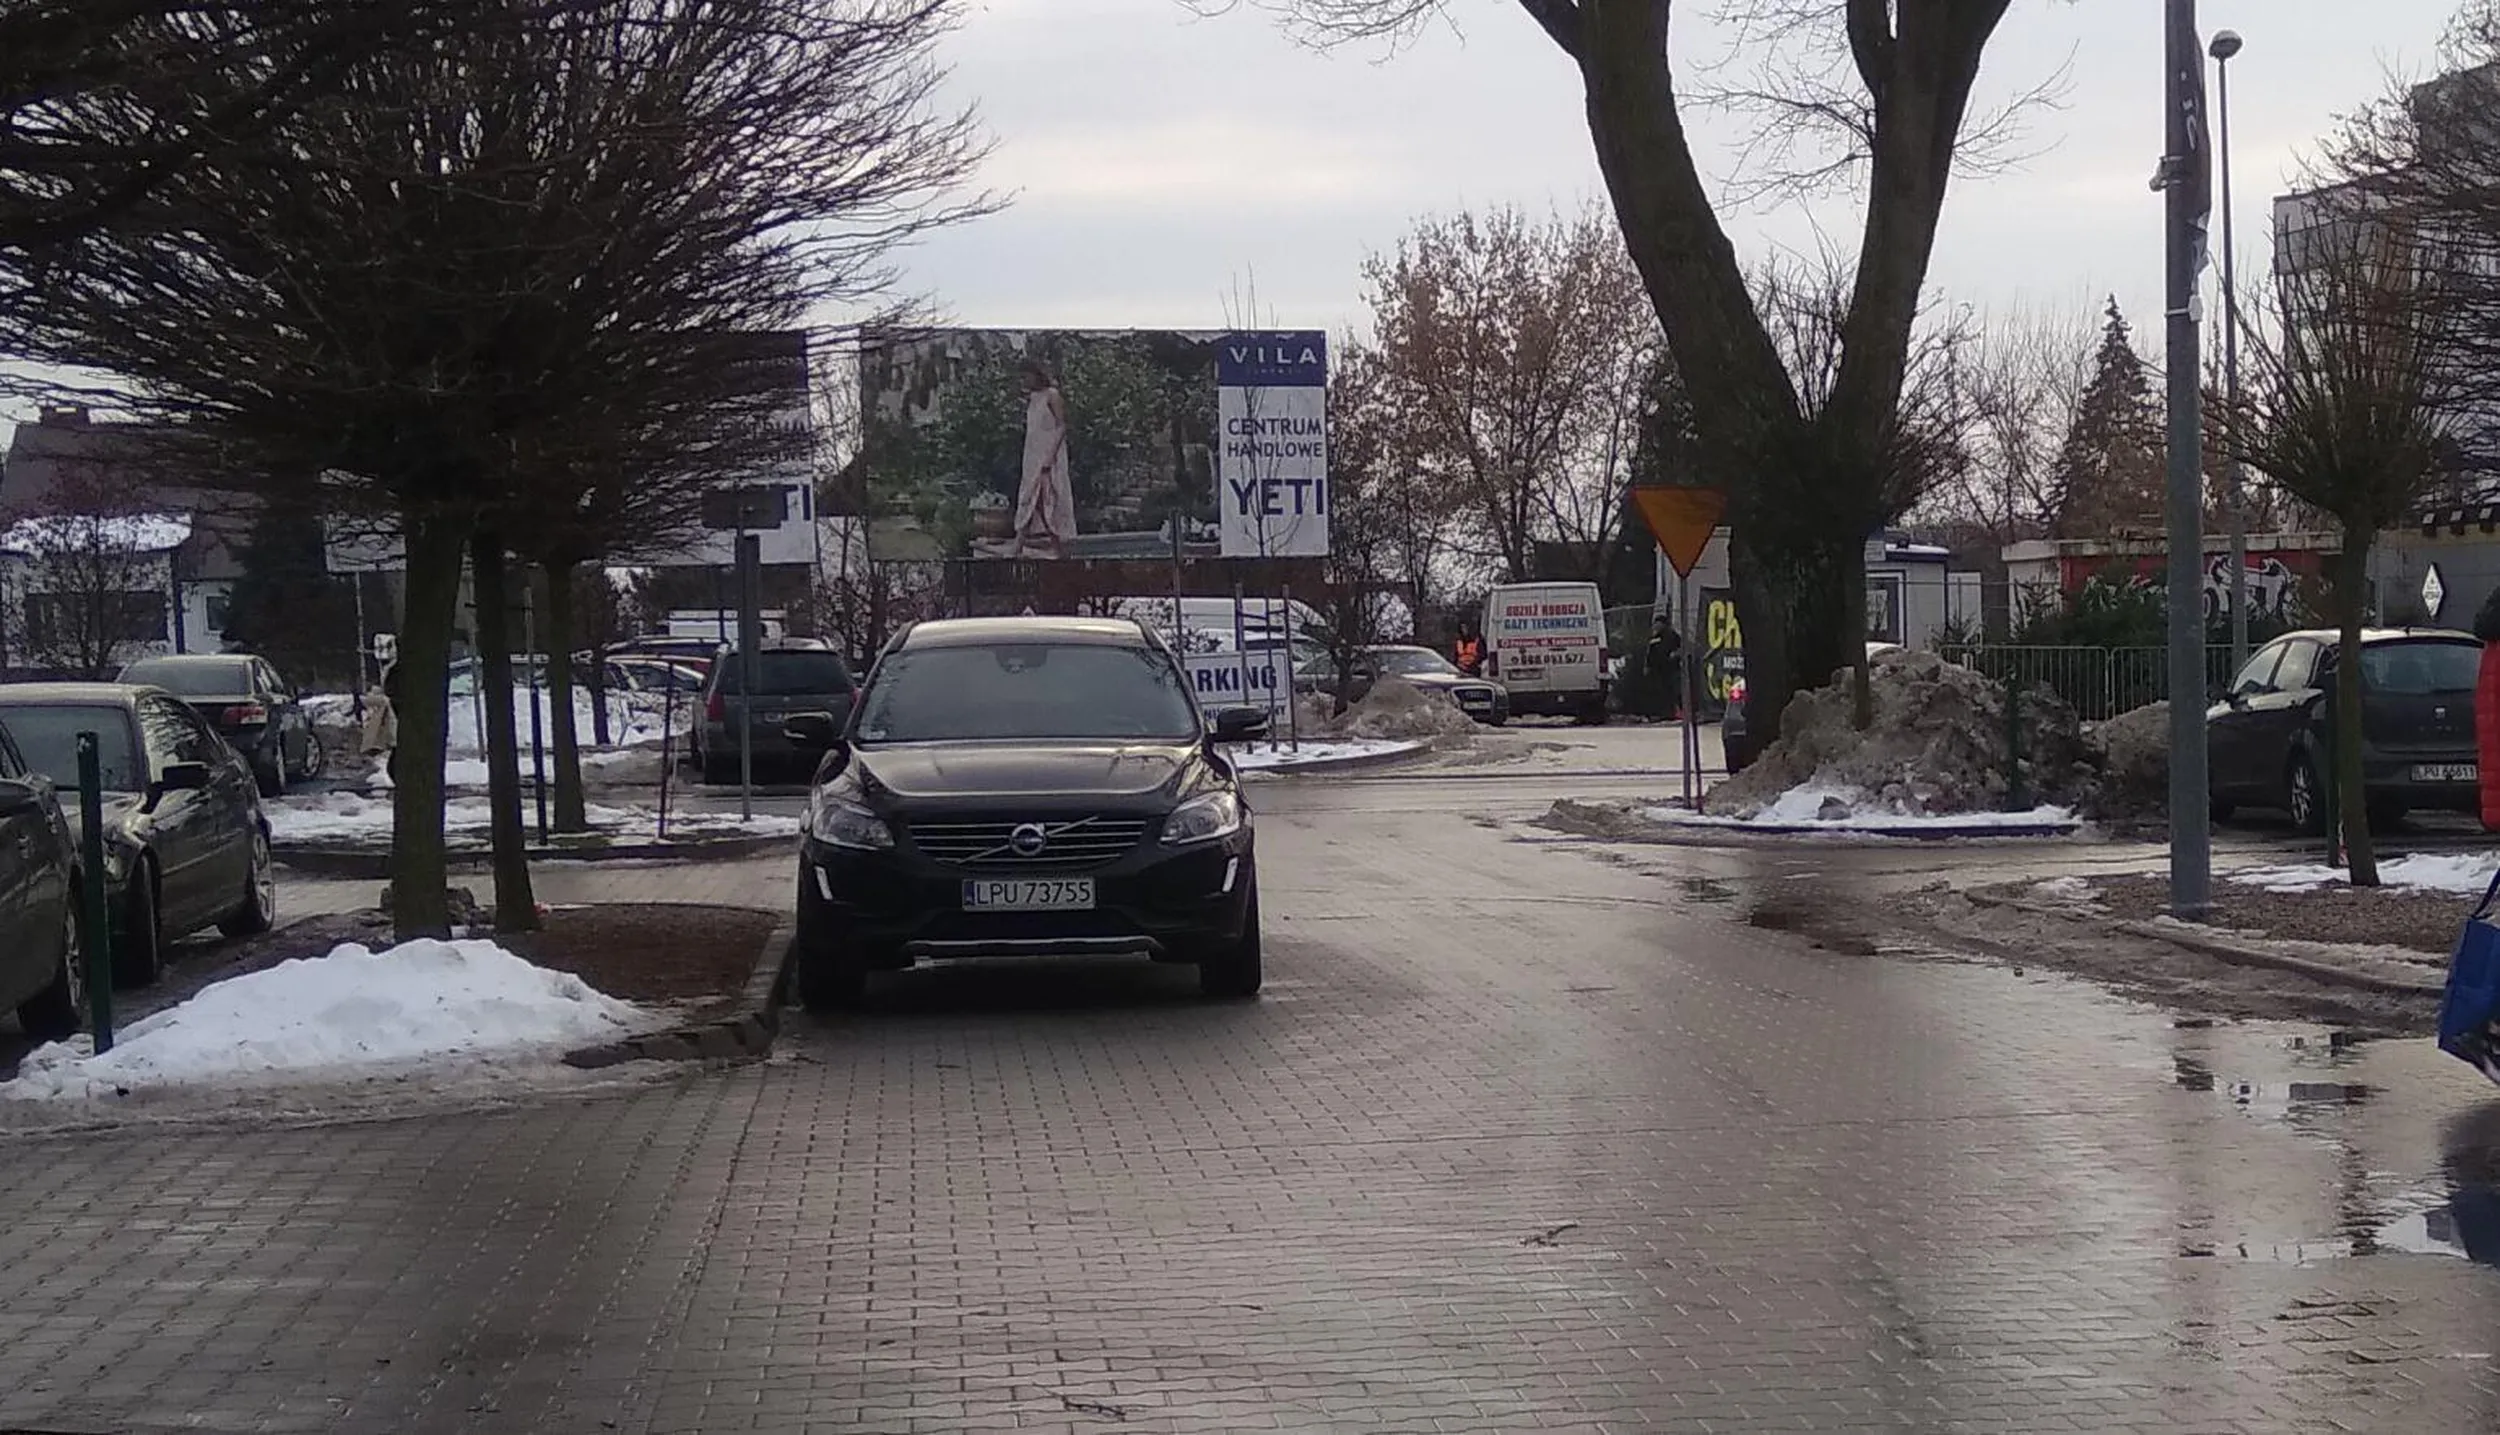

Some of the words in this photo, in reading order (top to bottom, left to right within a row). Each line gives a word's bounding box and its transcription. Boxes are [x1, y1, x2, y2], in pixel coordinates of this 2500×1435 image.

[1228, 346, 1318, 364] VILA
[1227, 417, 1322, 435] CENTRUM
[1227, 441, 1323, 458] HANDLOWE
[1228, 478, 1324, 516] YETI
[1504, 618, 1528, 629] GAZY
[976, 883, 1018, 904] LPU
[1024, 881, 1091, 903] 73755
